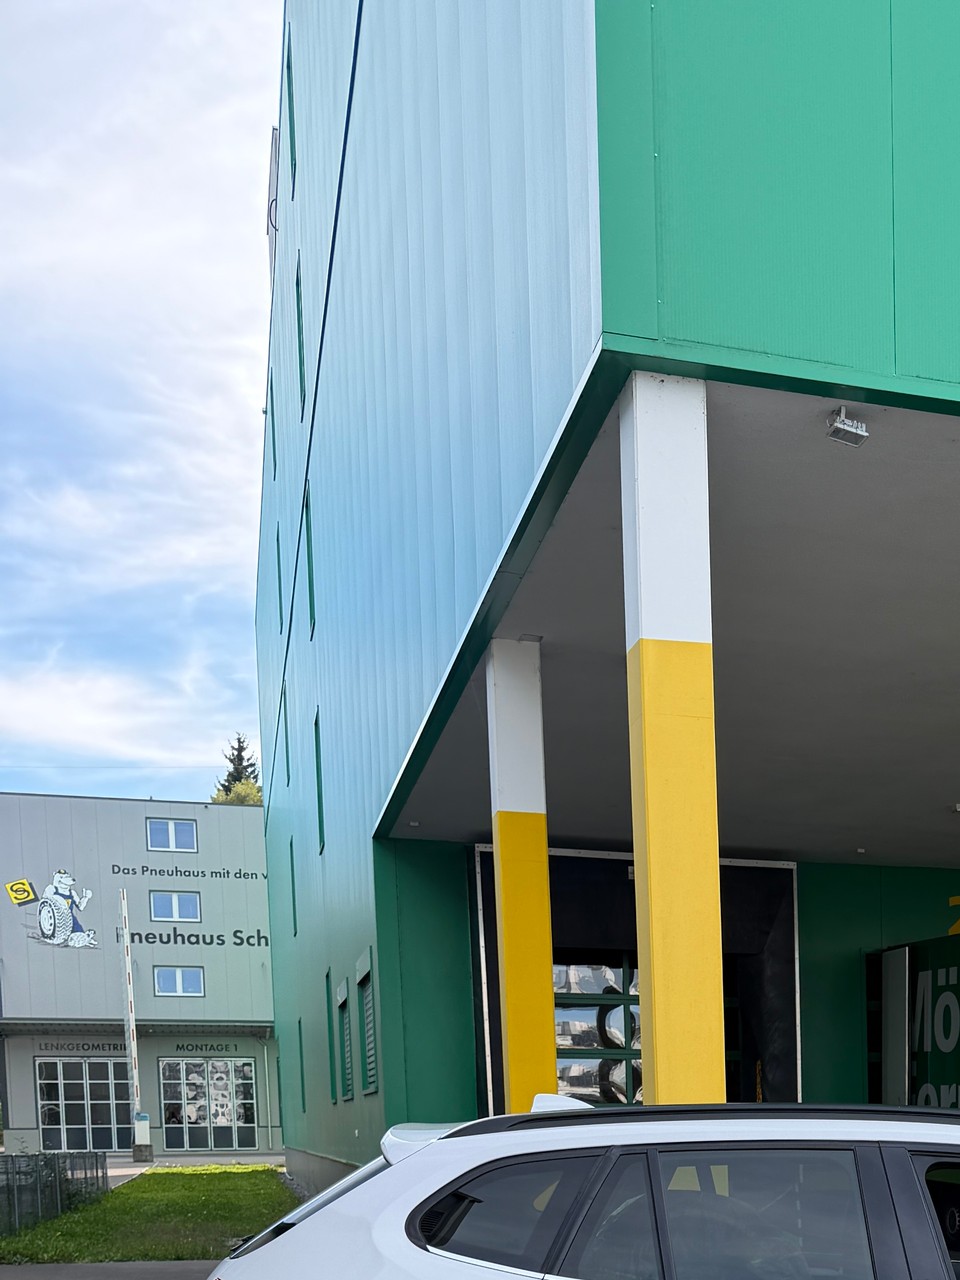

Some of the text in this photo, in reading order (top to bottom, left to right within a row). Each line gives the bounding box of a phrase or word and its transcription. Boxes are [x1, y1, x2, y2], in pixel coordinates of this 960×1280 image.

[111, 864, 137, 876] Das
[141, 865, 207, 878] Pneuhaus
[210, 867, 230, 879] mit
[233, 868, 258, 880] den
[232, 929, 269, 947] Sch
[175, 1043, 238, 1052] MONTAGE 1
